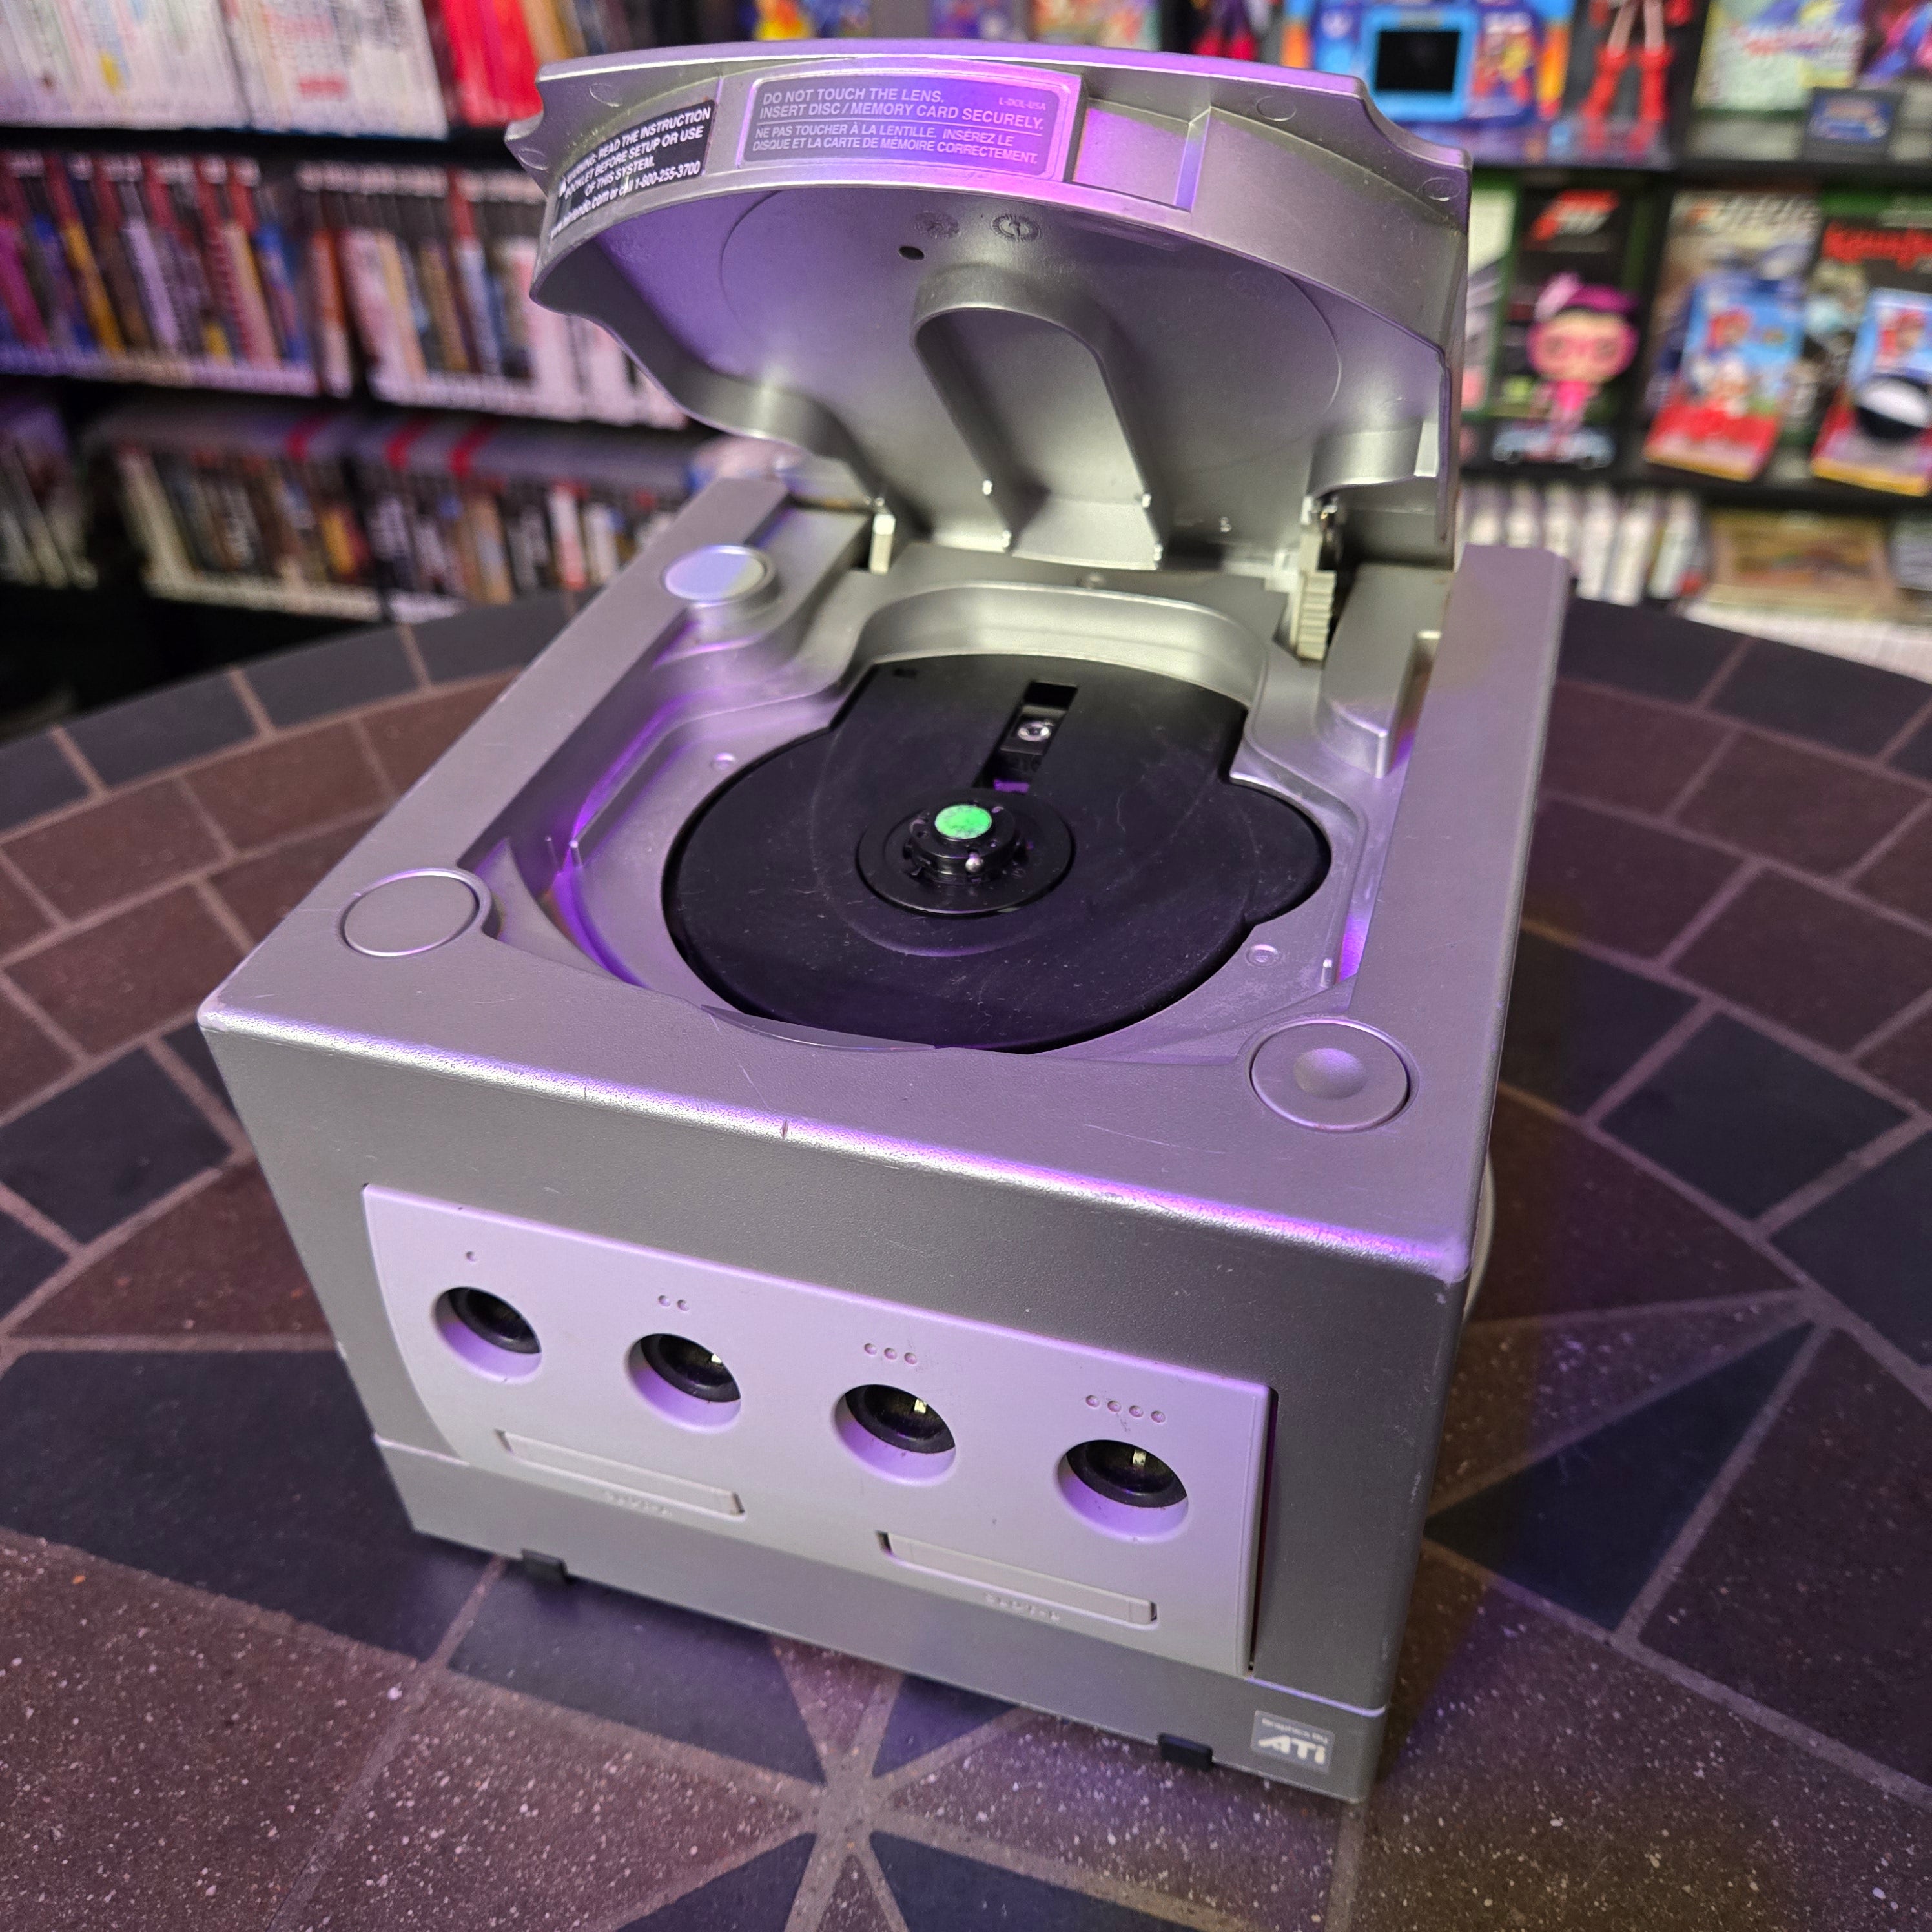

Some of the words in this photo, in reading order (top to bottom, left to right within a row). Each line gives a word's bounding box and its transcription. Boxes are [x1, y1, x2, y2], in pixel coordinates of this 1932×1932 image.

[763, 92, 782, 105] DO
[785, 89, 814, 103] NOT
[817, 88, 865, 101] TOUCH
[869, 88, 898, 101] THE
[901, 89, 945, 103] LENS.
[760, 104, 806, 119] INSERT
[808, 103, 841, 116] DISC
[850, 102, 914, 116] MEMORY
[916, 105, 958, 119] CARD
[962, 108, 1044, 130] SECURELY.
[598, 139, 620, 161] READ
[622, 130, 639, 148] THE
[640, 107, 711, 139] INSTRUCTION
[755, 127, 770, 139] NE
[772, 126, 792, 138] PAS
[796, 124, 848, 136] TOUCHER
[849, 122, 859, 135] À
[861, 124, 876, 135] LA
[879, 125, 937, 138] LENTILLE.
[943, 128, 996, 145] INSÉREZ
[997, 134, 1014, 147] LE
[595, 150, 628, 177] BEFORE
[628, 137, 661, 159] SETUP
[661, 132, 679, 148] OR
[680, 125, 704, 142] USE
[752, 138, 791, 152] DISQUE
[792, 138, 807, 149] ET
[807, 137, 821, 149] LA
[823, 137, 861, 149] CARTE
[863, 137, 879, 149] DE
[937, 141, 1038, 165] CORRECTEMENT.
[584, 181, 596, 196] OF
[597, 170, 615, 190] THIS
[615, 154, 655, 180] SYSTEM.
[635, 160, 701, 189] 1-800-255-3700
[1259, 1734, 1326, 1765] ATI
